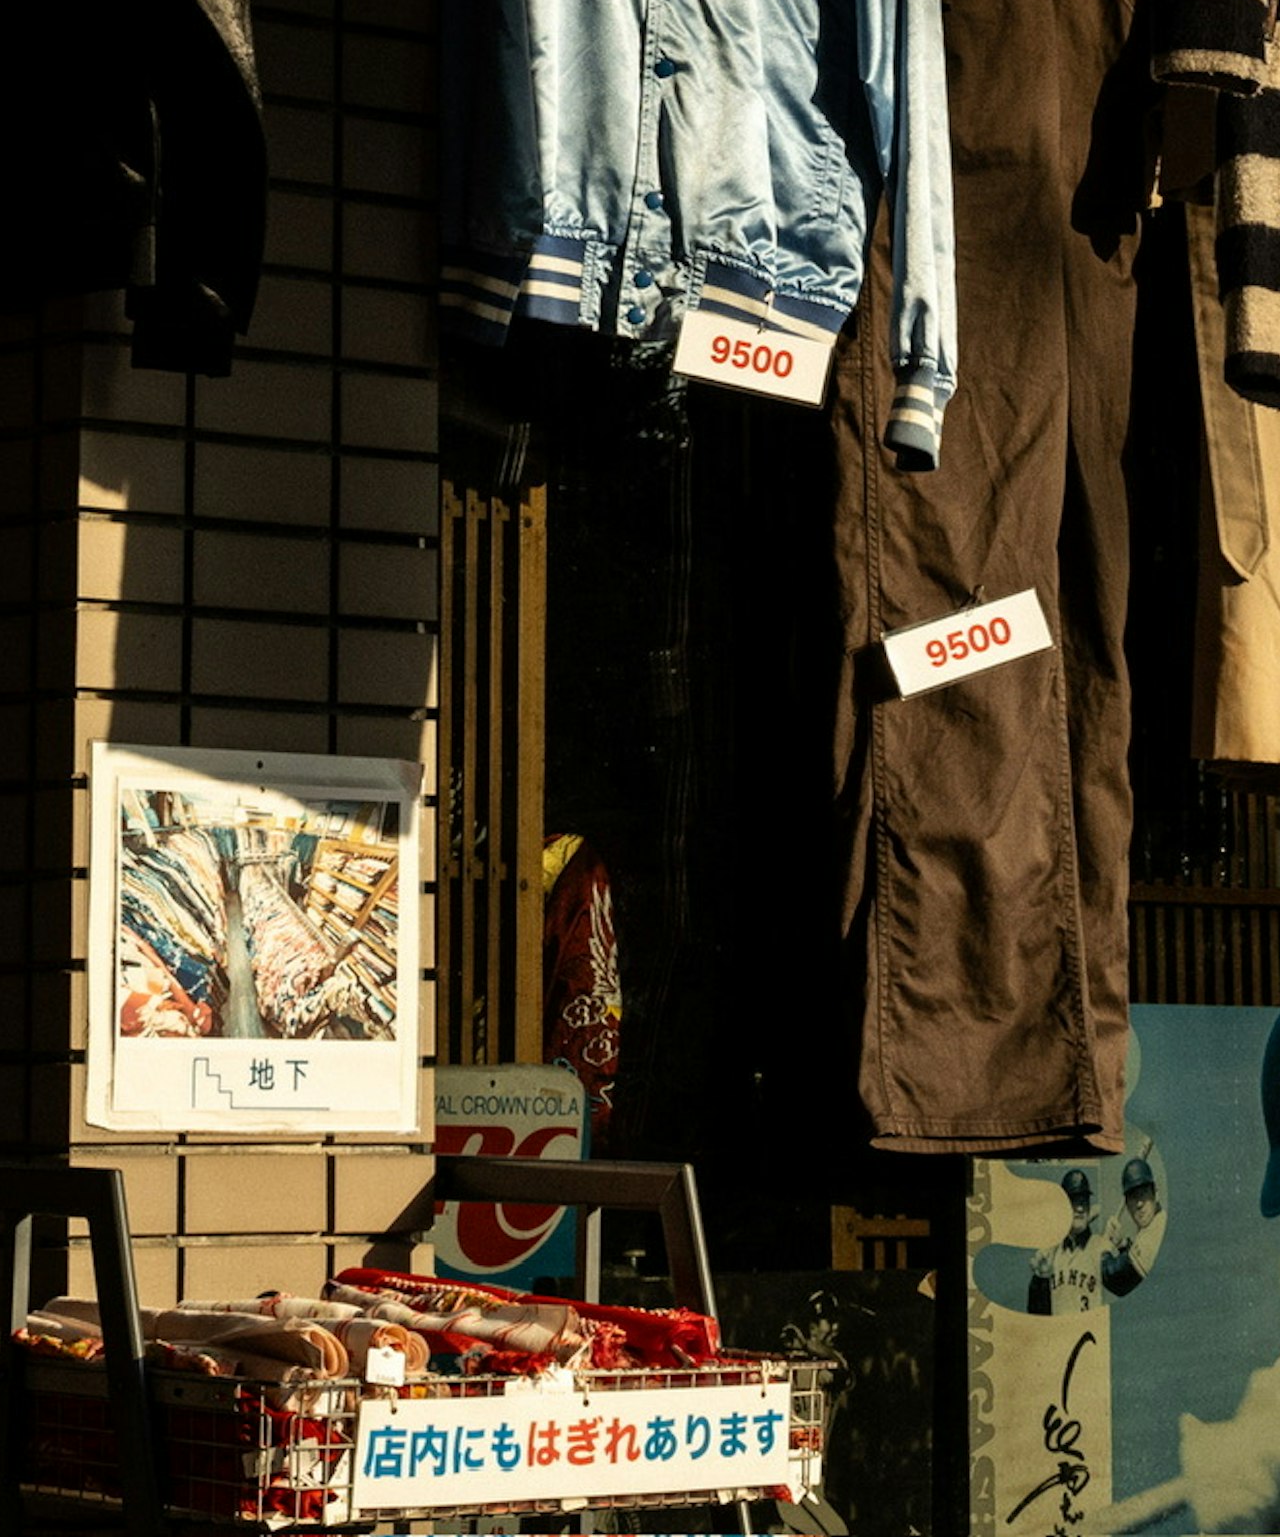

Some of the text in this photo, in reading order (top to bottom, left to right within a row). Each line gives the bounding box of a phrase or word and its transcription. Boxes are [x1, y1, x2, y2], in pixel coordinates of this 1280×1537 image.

[709, 335, 794, 378] 9500
[924, 616, 1012, 668] 9500
[248, 1057, 308, 1092] 地下
[461, 1095, 528, 1115] CROWN
[532, 1096, 580, 1116] COLA
[363, 1407, 785, 1479] 店内にもはぎれあります
